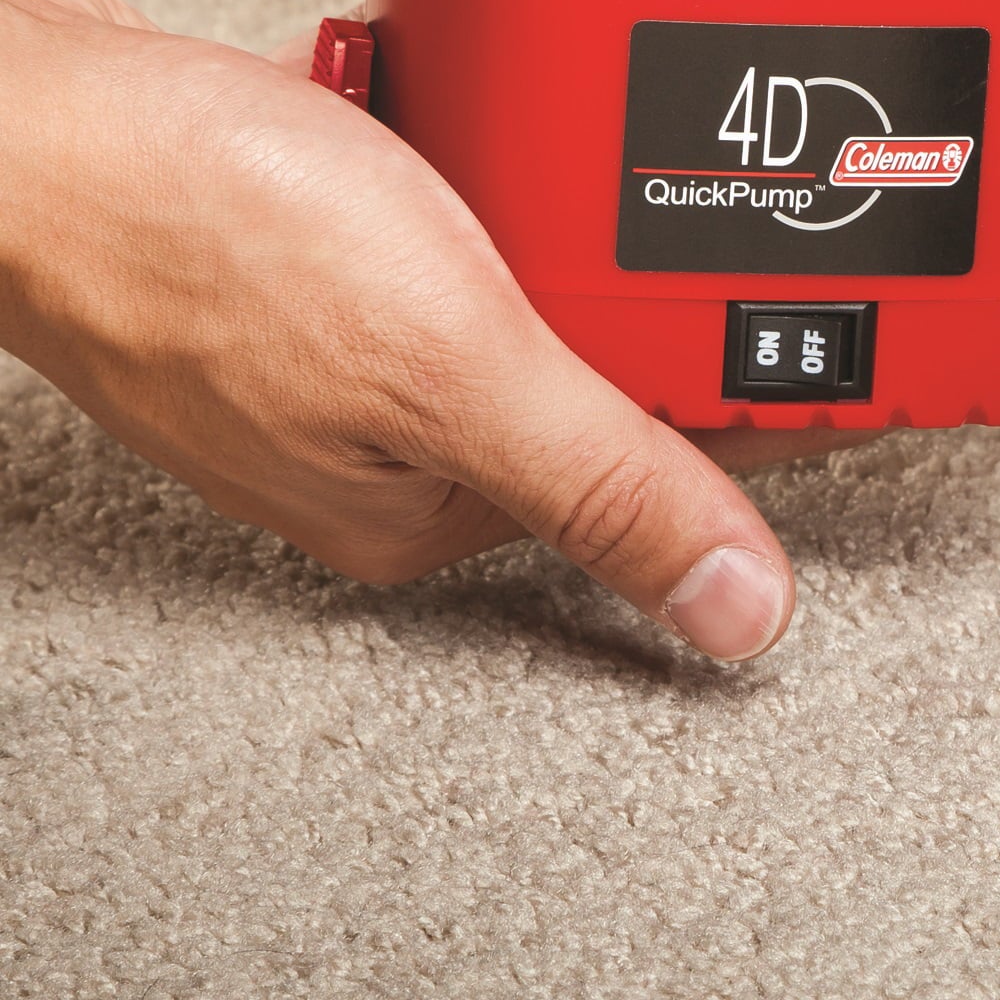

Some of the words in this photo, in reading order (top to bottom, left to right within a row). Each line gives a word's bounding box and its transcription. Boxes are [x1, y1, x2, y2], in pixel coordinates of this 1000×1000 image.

[718, 66, 808, 167] 4D
[845, 143, 941, 173] Coleman
[756, 331, 781, 367] ON
[801, 329, 827, 375] OFF
